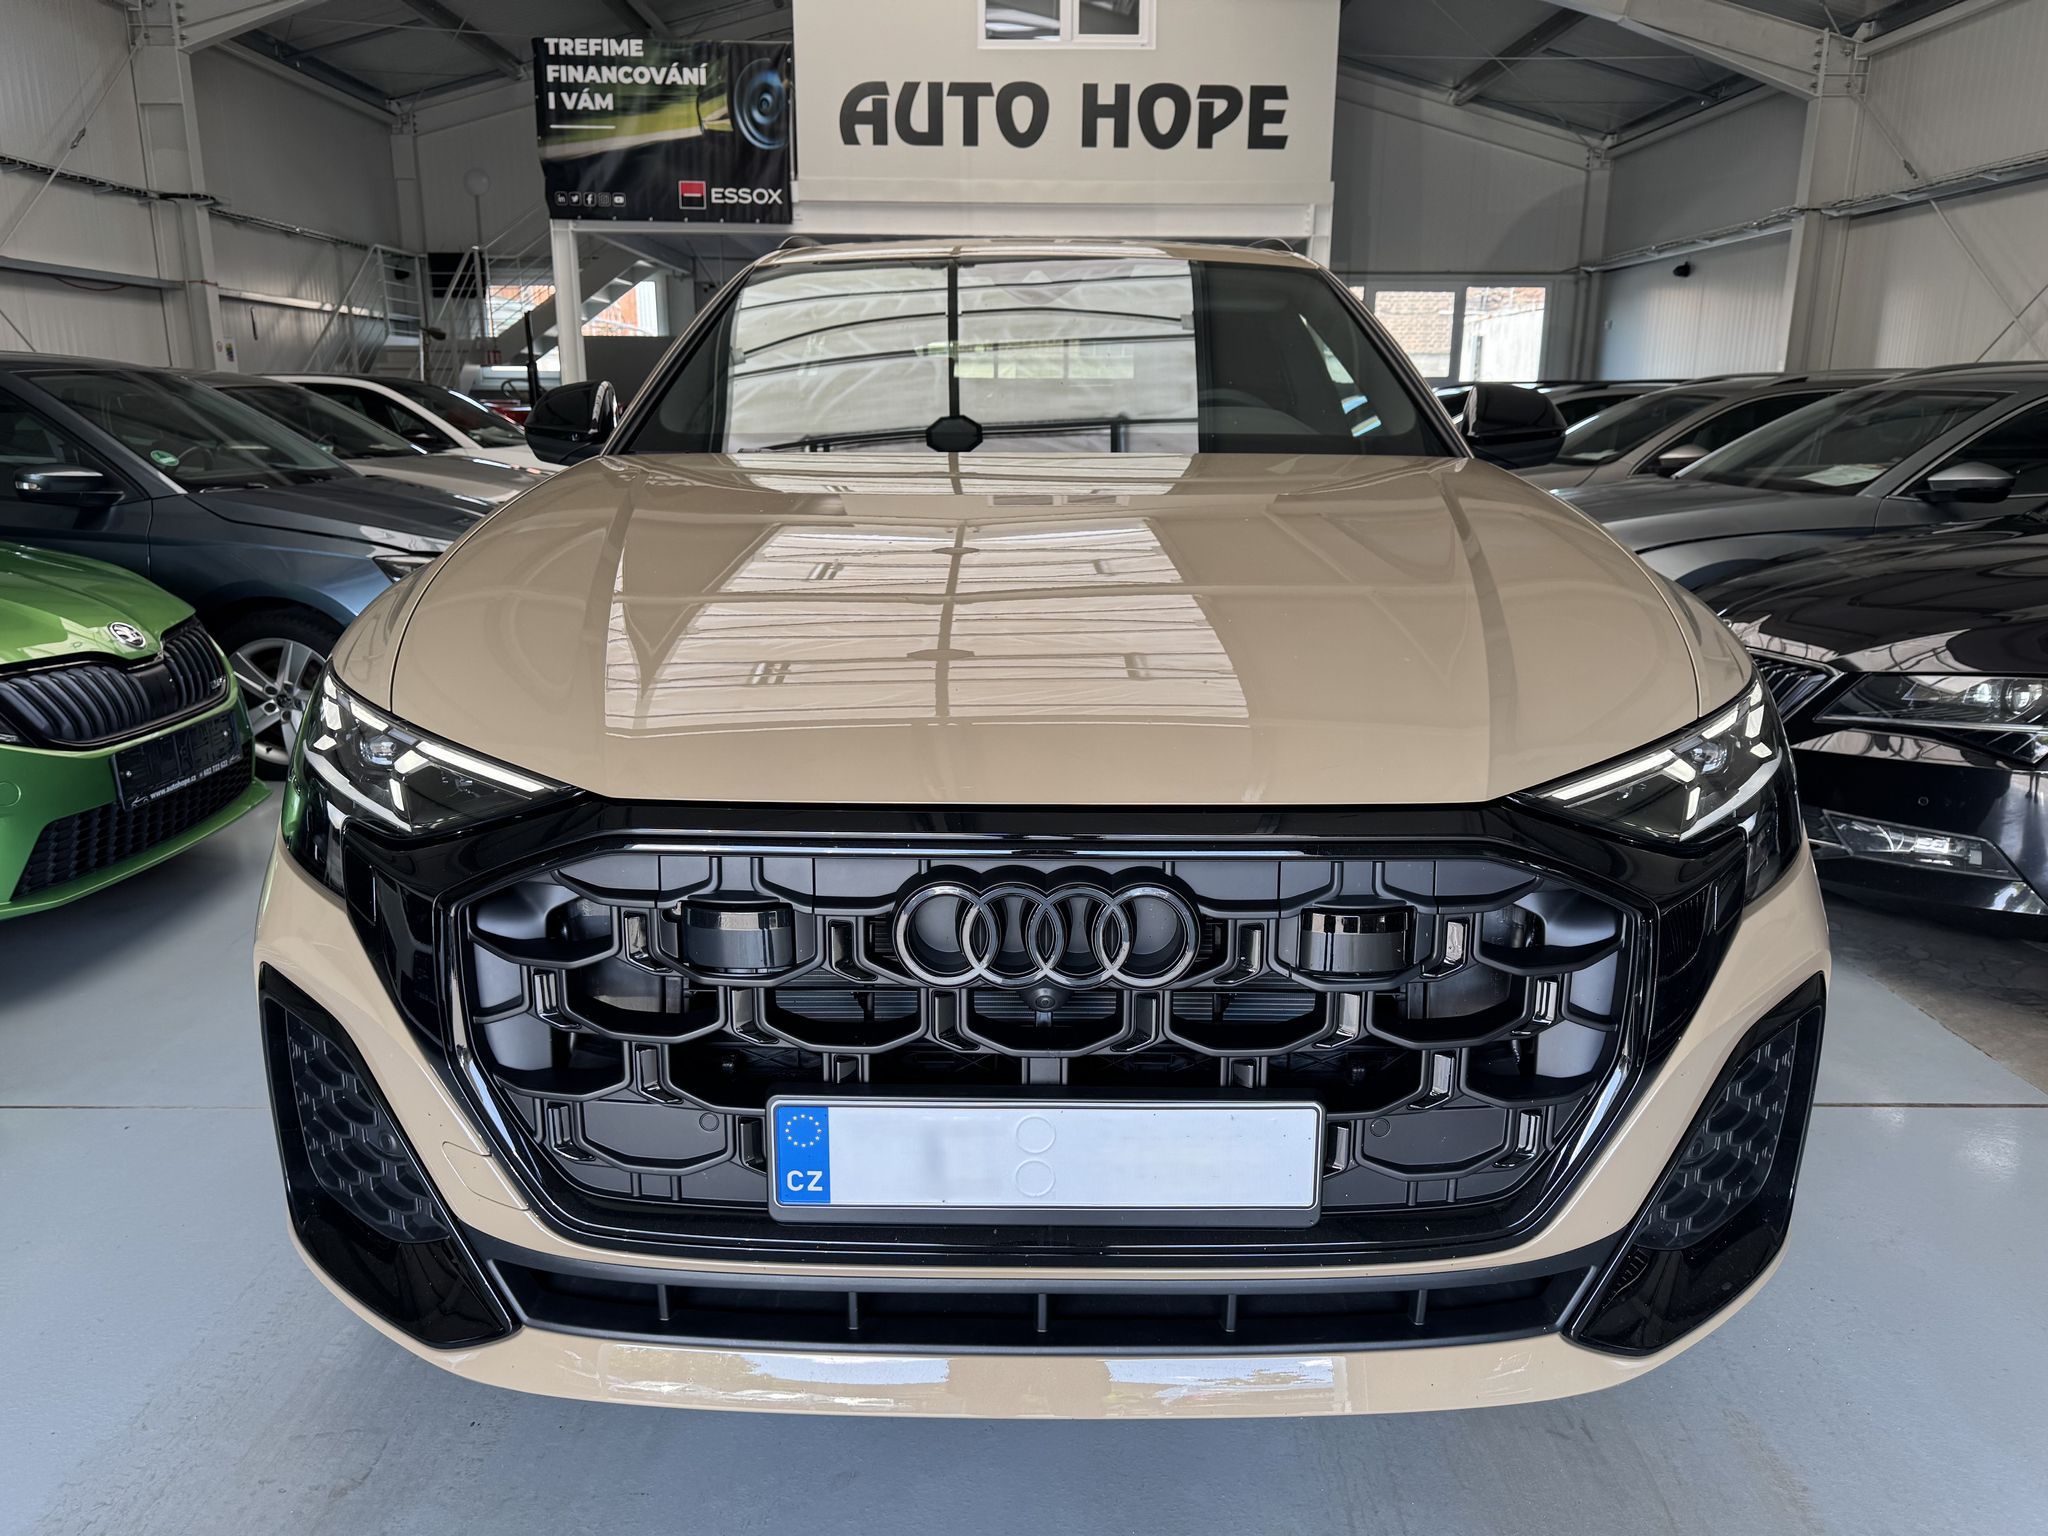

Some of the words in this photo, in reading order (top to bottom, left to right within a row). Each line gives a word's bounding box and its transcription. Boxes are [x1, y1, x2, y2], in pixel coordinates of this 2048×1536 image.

[544, 38, 644, 57] TREFIME
[546, 62, 708, 85] FINANCOVÁNÍ
[548, 92, 556, 110] I
[560, 88, 614, 111] VÁM
[839, 81, 1050, 148] AUTO
[1081, 82, 1289, 150] HOPE
[711, 188, 783, 205] ESSOX
[786, 1169, 823, 1192] CZ
